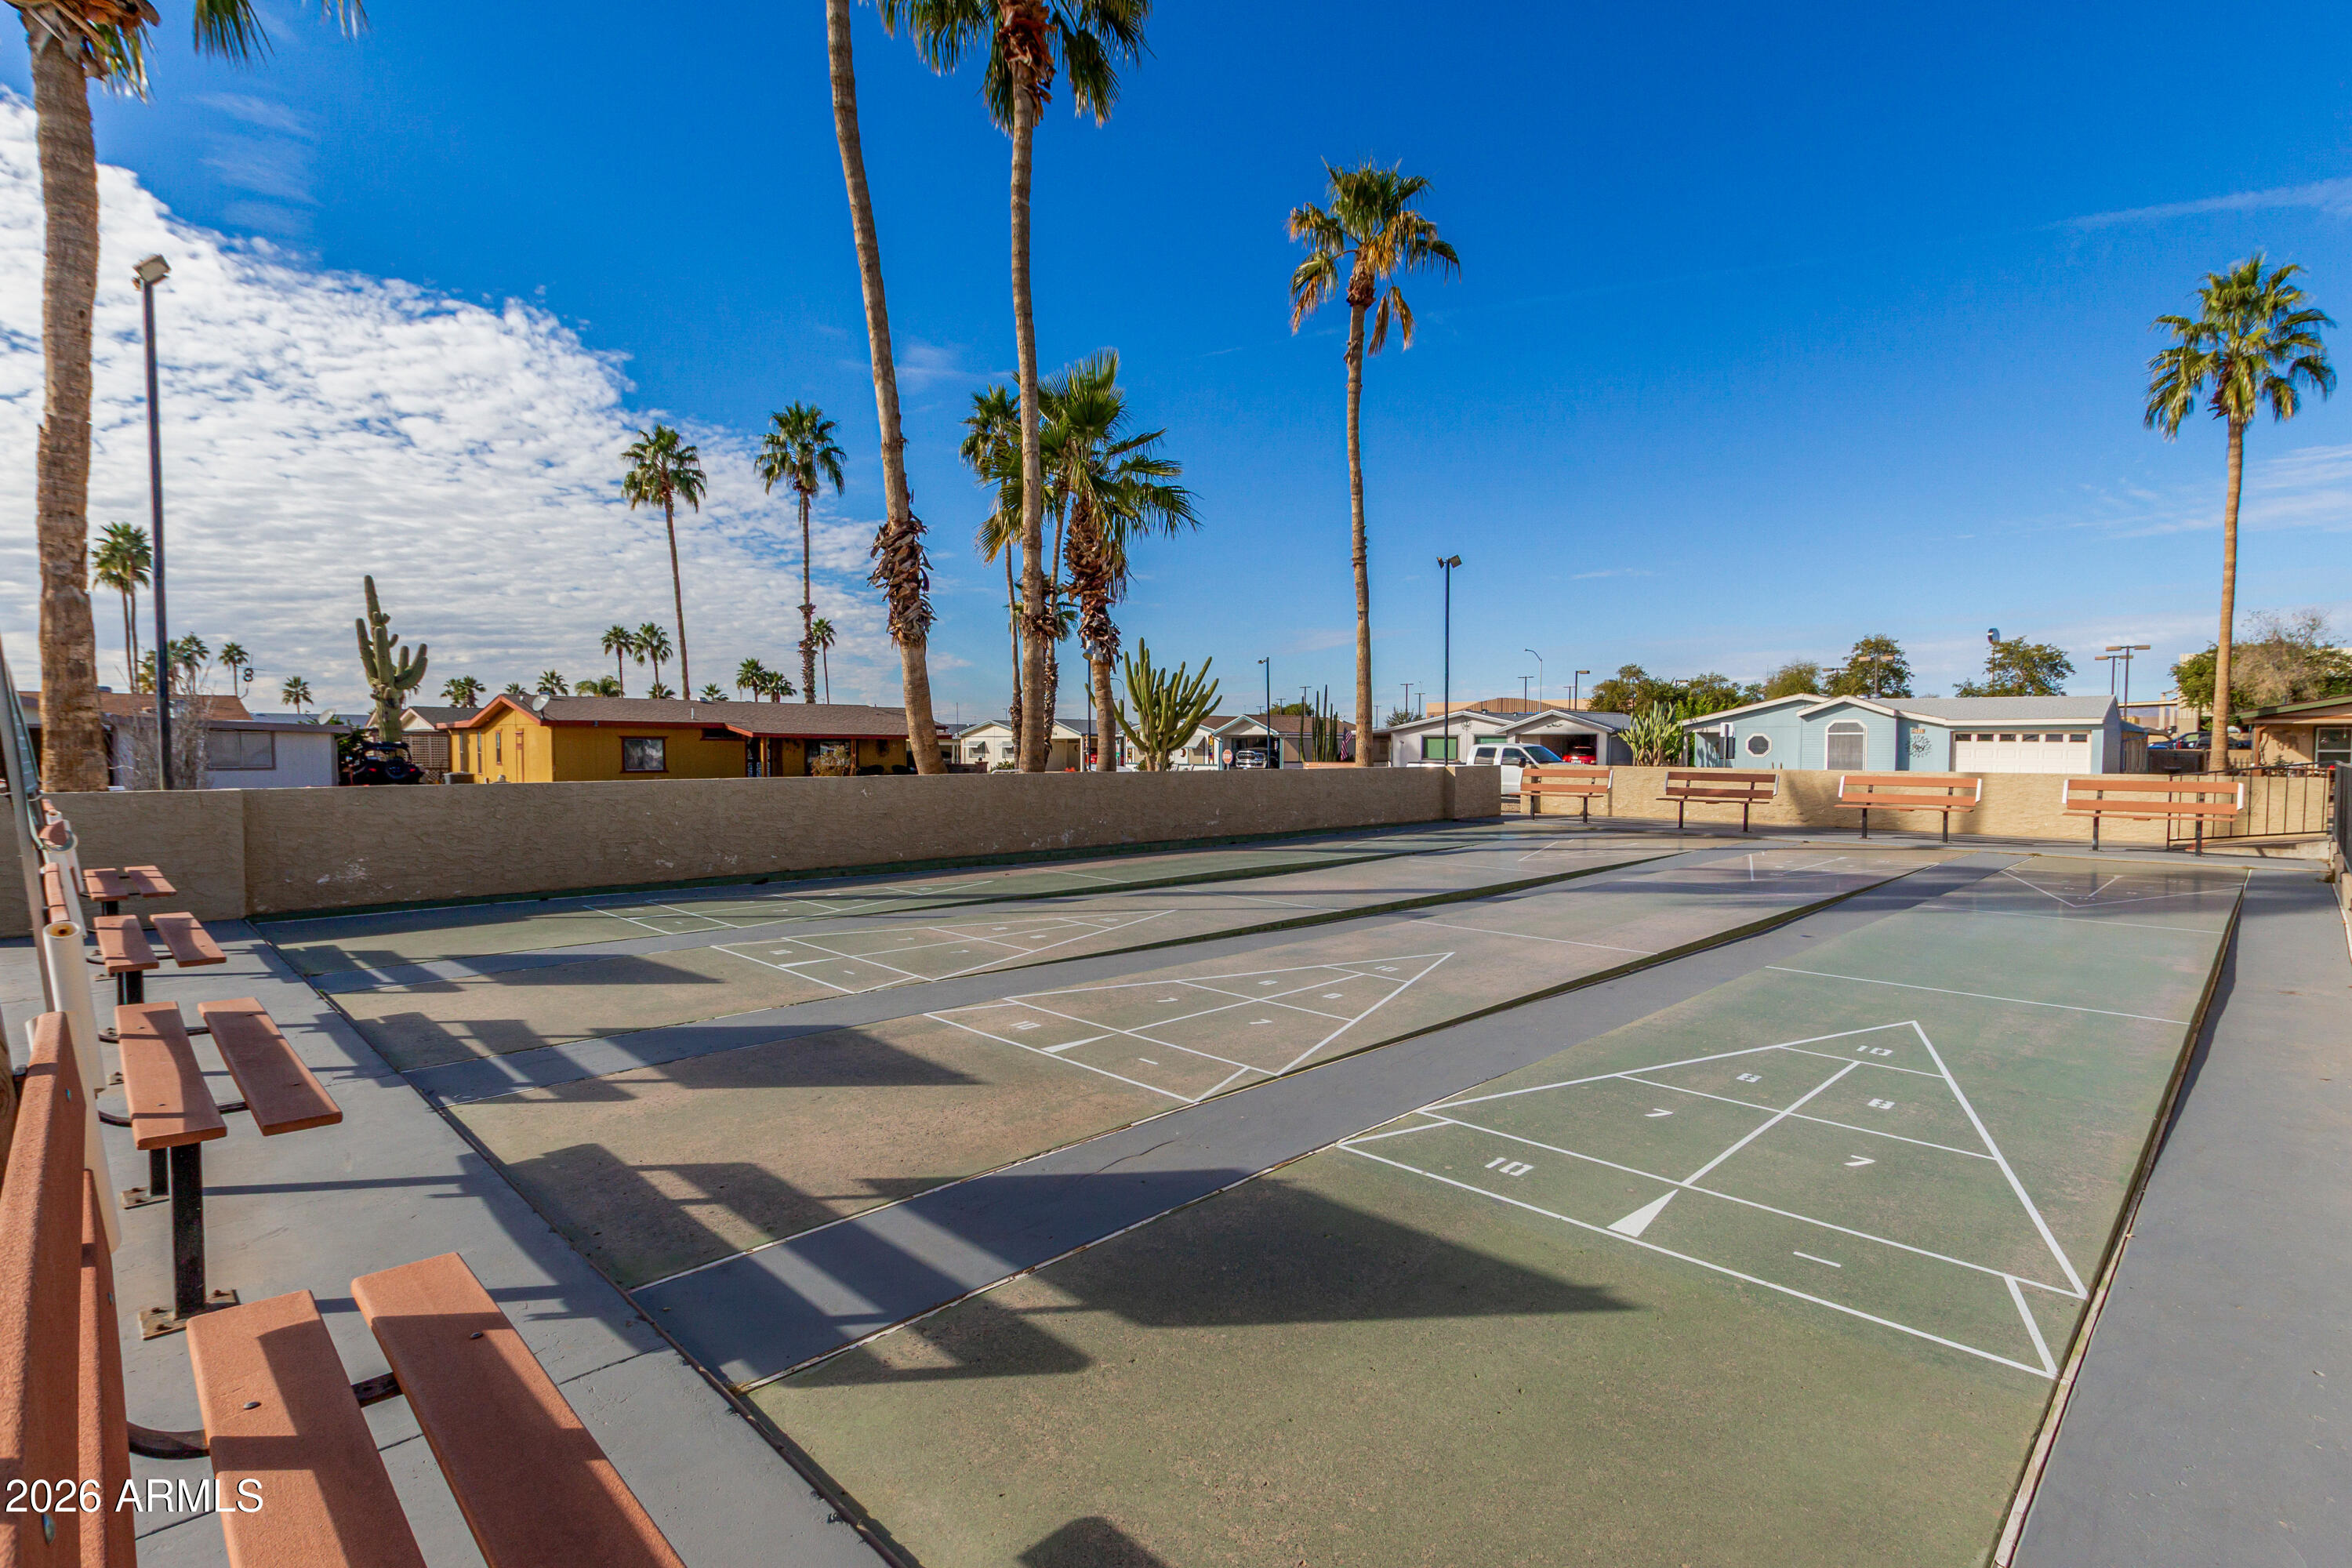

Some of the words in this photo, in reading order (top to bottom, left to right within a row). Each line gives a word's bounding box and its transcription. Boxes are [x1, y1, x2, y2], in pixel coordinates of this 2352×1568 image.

[1010, 1020, 1042, 1030] 10
[1856, 1045, 1893, 1056] 10
[1736, 1073, 1762, 1083] 8
[1867, 1098, 1896, 1109] 8
[1644, 1108, 1674, 1117] 7
[1484, 1156, 1534, 1176] 10
[1843, 1155, 1876, 1167] 7
